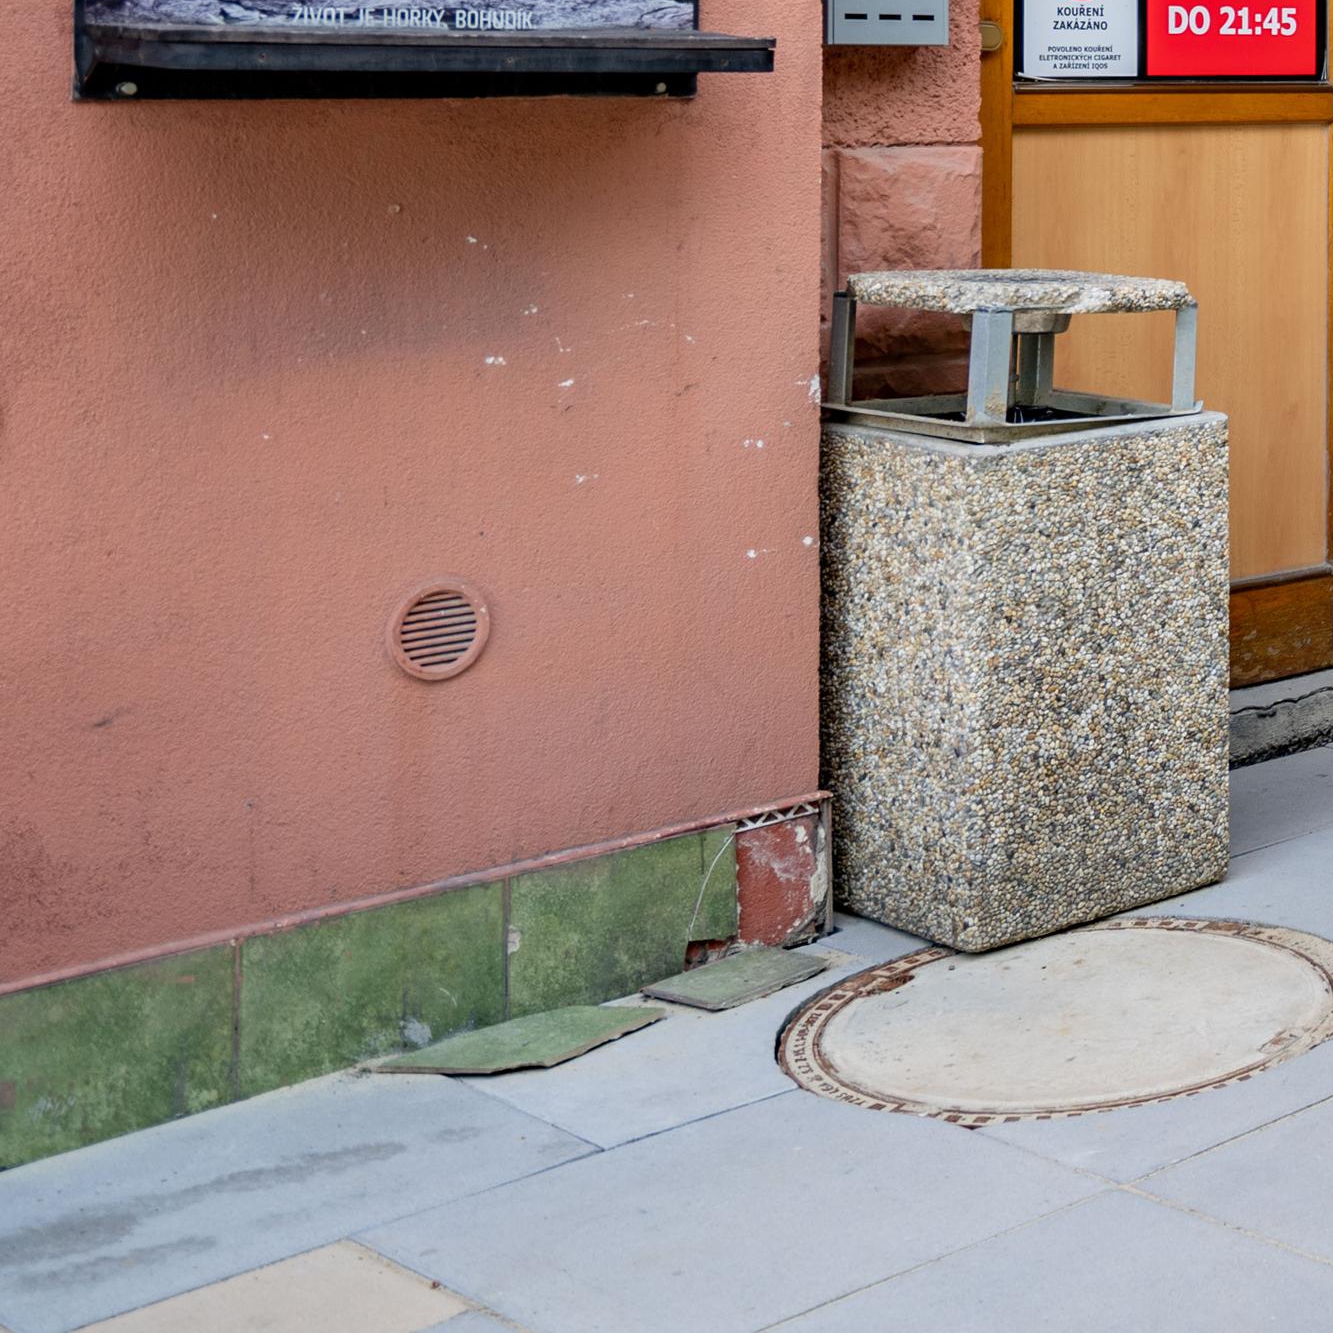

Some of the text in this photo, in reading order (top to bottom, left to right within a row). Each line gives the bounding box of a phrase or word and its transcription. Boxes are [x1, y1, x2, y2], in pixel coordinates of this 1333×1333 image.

[292, 4, 347, 28] ŽIVOT
[357, 8, 376, 27] JE
[1057, 4, 1104, 17] KOUŘENÍ
[1053, 18, 1108, 30] ZAKÁZÁNO
[1167, 5, 1298, 36] DO 21:45
[1083, 45, 1113, 53] KOUŘENÍ
